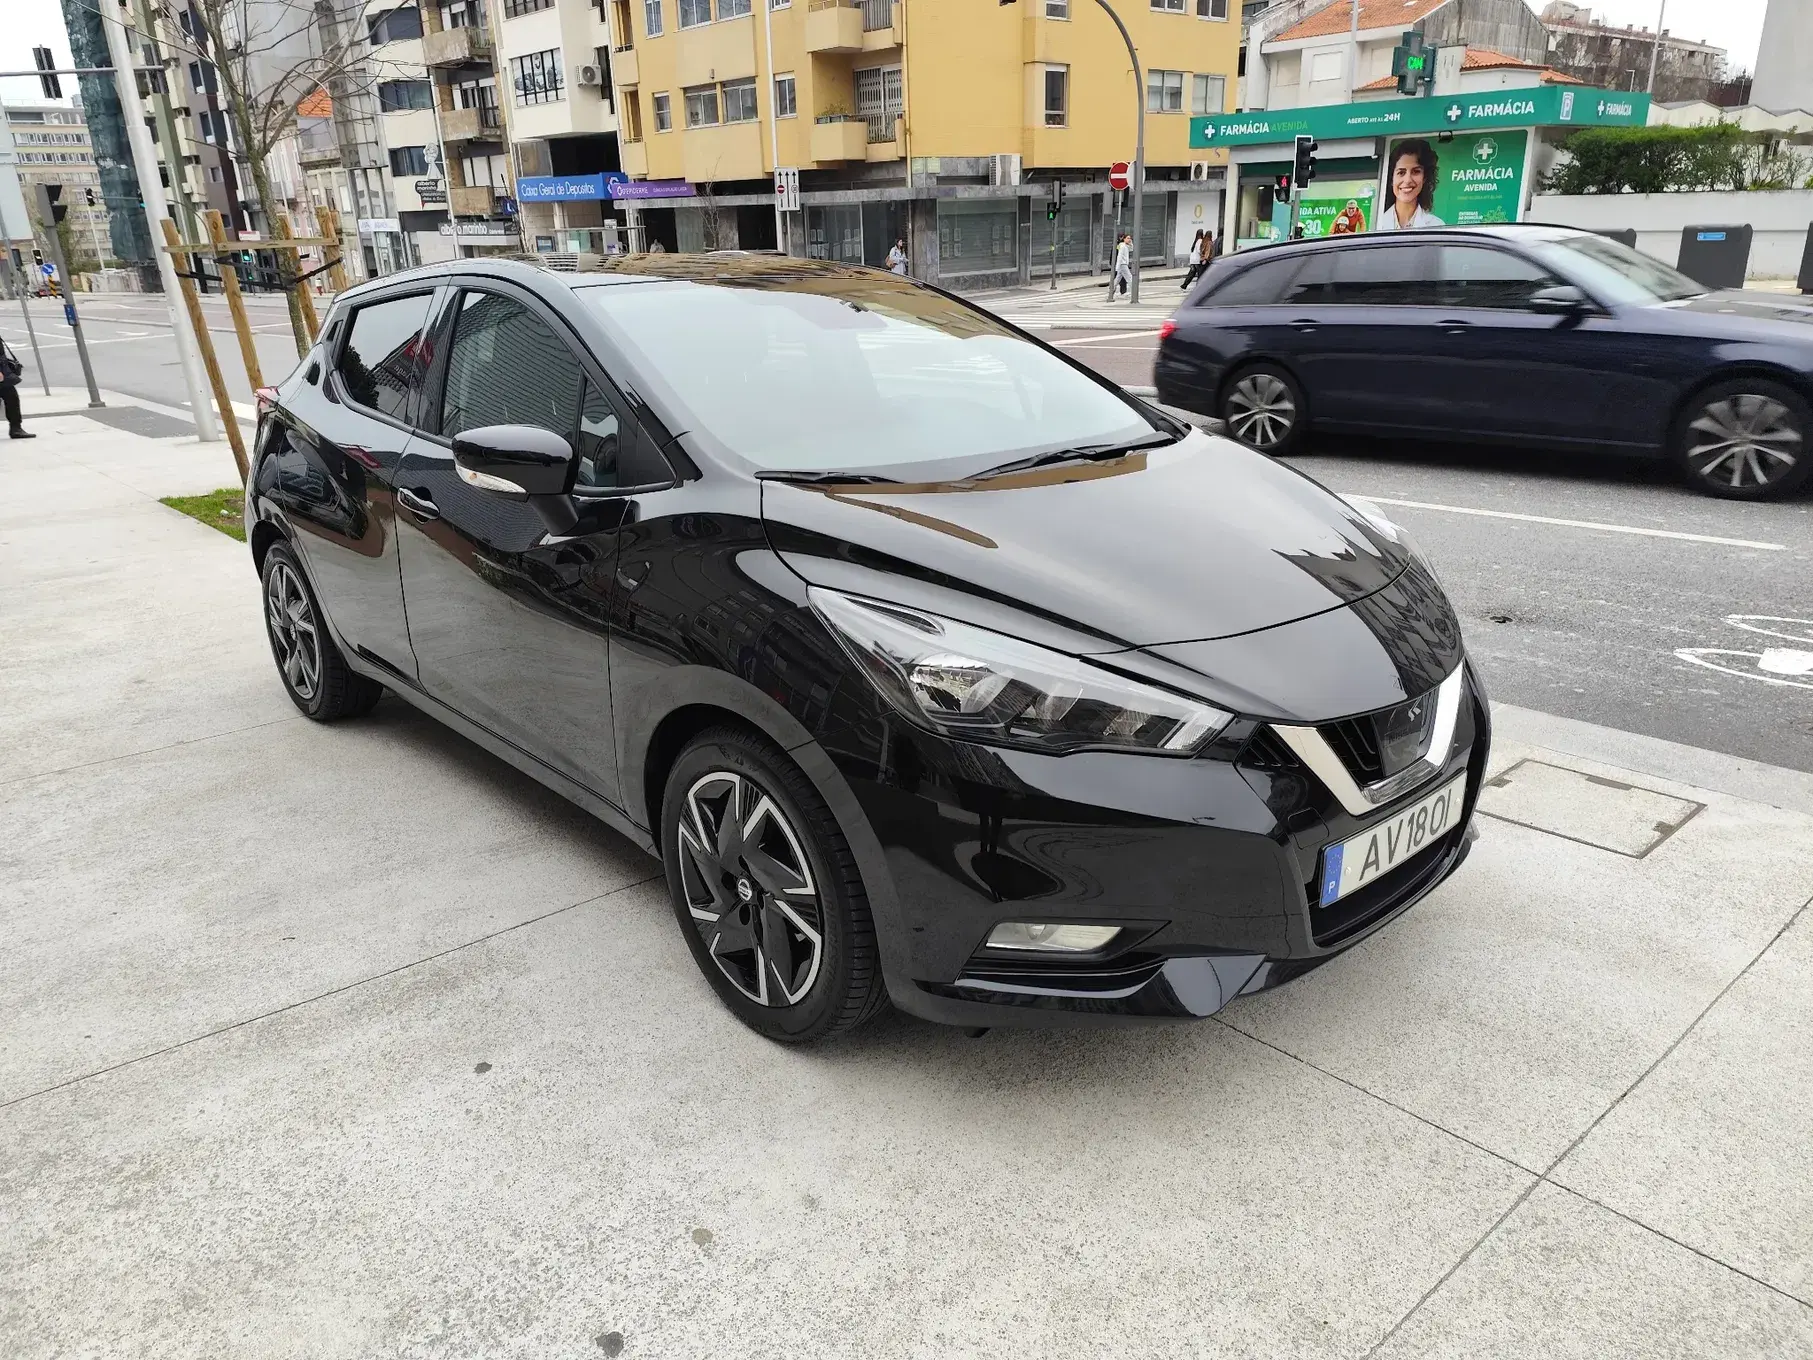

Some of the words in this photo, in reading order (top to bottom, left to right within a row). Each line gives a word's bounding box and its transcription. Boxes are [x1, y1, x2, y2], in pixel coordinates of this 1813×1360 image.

[1468, 99, 1535, 118] FARMÁCIA
[1605, 101, 1632, 116] FARMÁCIA
[1347, 117, 1369, 125] ABERTO
[1384, 112, 1401, 122] 24H
[1220, 120, 1270, 136] FARMÁCIA
[1270, 120, 1308, 132] AVENIDA
[1451, 166, 1514, 182] FARMÁCIA
[521, 184, 538, 197] Caixa
[539, 182, 556, 196] Geral
[556, 182, 565, 194] de
[1463, 182, 1498, 192] AVENIDA
[1299, 207, 1313, 216] IDA
[1314, 206, 1337, 215] ATIVA
[462, 222, 488, 235] marinho
[1328, 880, 1336, 894] P
